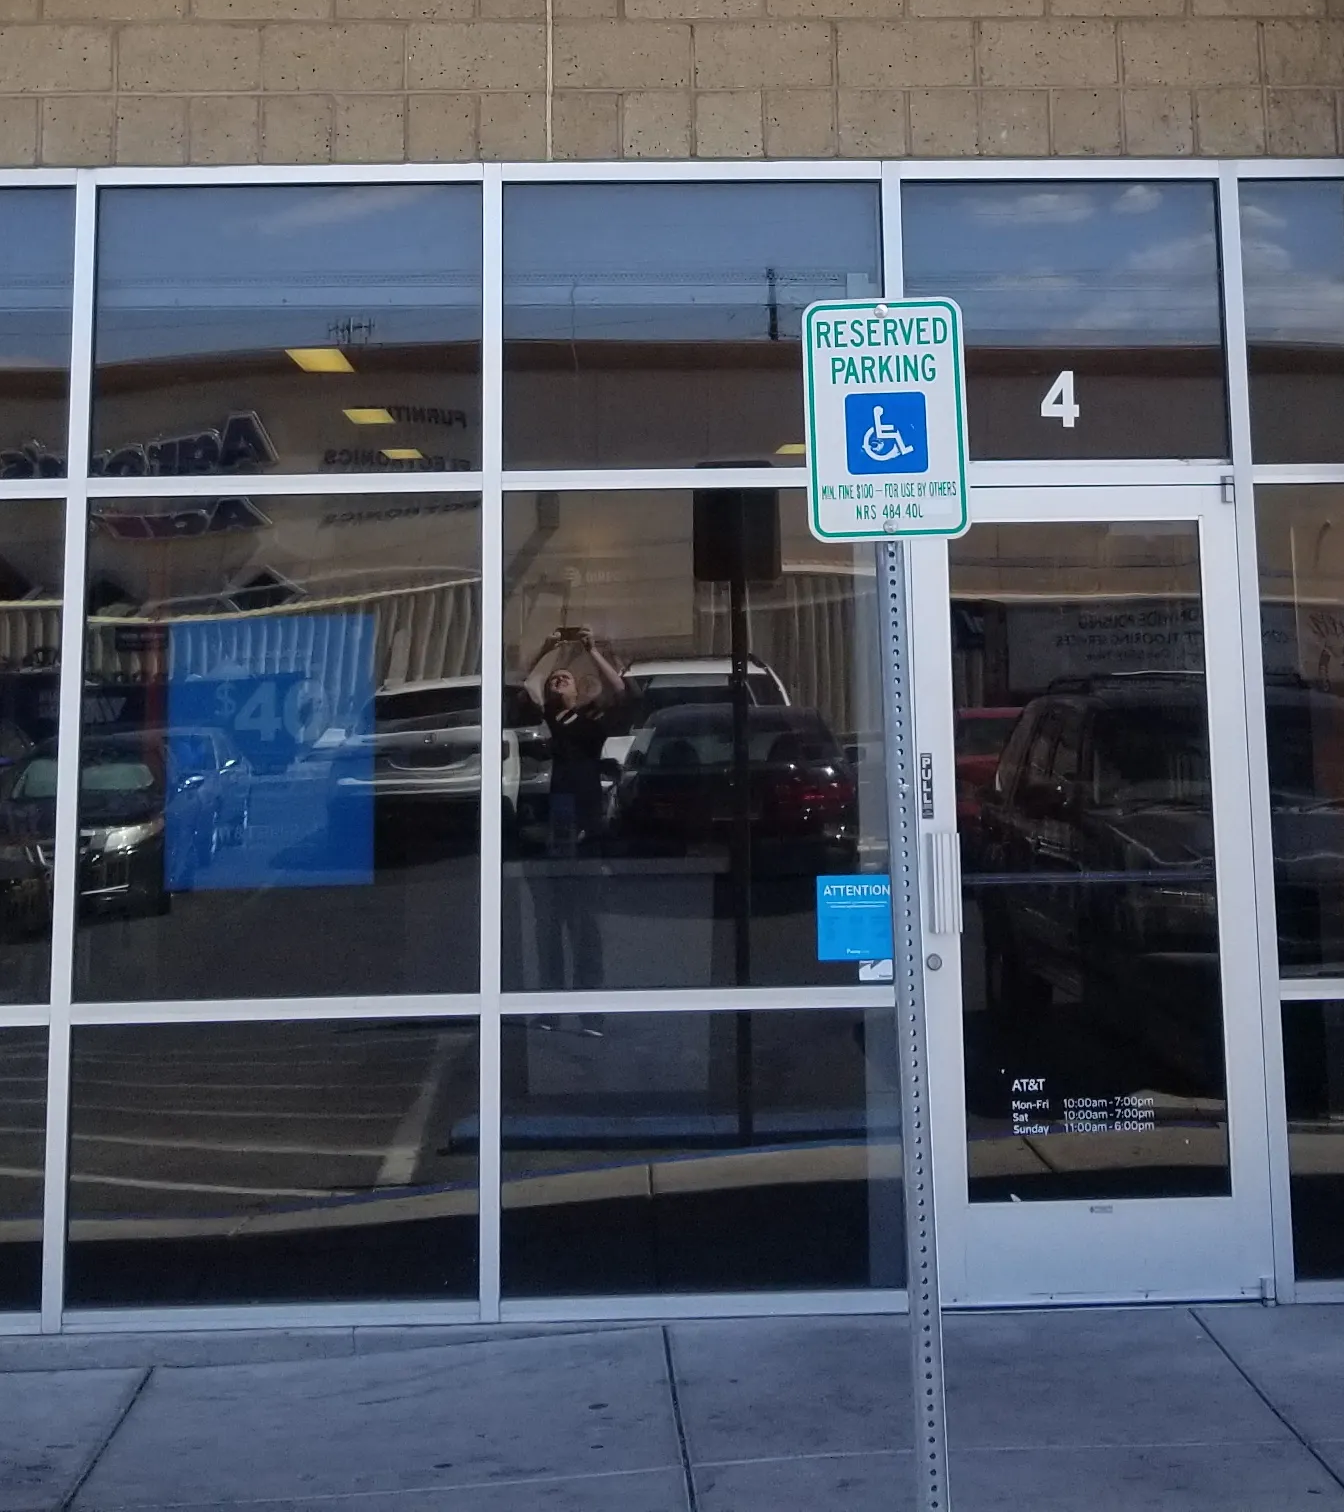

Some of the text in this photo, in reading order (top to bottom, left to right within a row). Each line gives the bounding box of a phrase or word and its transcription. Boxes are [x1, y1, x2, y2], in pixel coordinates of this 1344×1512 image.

[816, 317, 948, 348] RESERVED
[831, 353, 936, 385] PARKING
[1040, 370, 1080, 428] 4
[839, 484, 854, 500] FINE
[856, 483, 873, 499] $100
[884, 483, 899, 498] FOR
[901, 482, 915, 498] USE
[918, 482, 927, 497] BY
[929, 481, 957, 497] OTHERS
[856, 504, 877, 520] NRS
[921, 757, 932, 804] PULL
[823, 884, 891, 897] ATTENTION
[1011, 1078, 1046, 1092] AT&T
[1011, 1099, 1050, 1110] Mon-Fri
[1063, 1097, 1108, 1109] 10:00am
[1114, 1096, 1154, 1108] 7:00pm
[1012, 1112, 1029, 1123] Sat
[1063, 1110, 1108, 1121] 10:00am
[1114, 1108, 1155, 1120] 7:00pm
[1013, 1124, 1050, 1136] Sunday
[1064, 1122, 1107, 1133] 11:00am
[1114, 1121, 1155, 1132] 6:00pm
